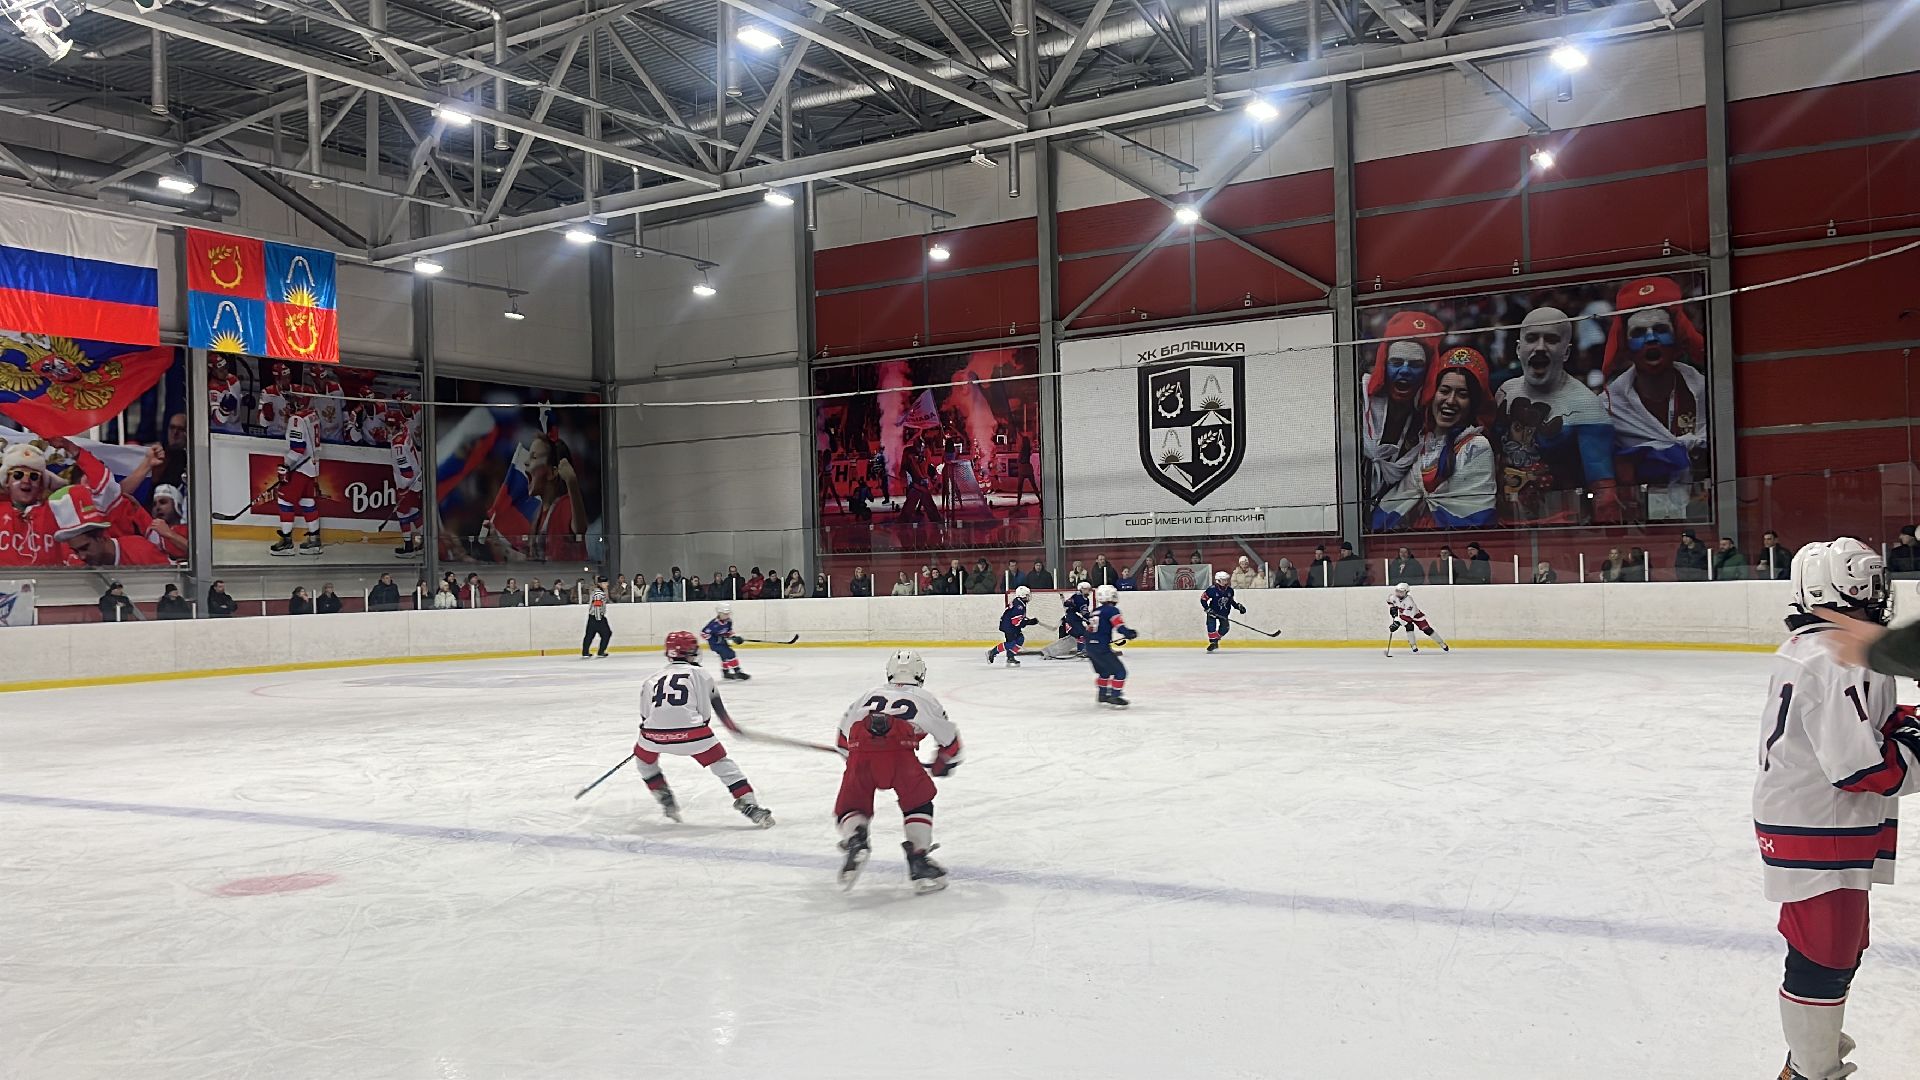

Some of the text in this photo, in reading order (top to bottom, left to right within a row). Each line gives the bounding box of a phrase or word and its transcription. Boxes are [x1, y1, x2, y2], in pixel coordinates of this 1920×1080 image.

[1137, 340, 1246, 363] ХК БАЛАШИХА
[345, 480, 397, 514] Boh
[1125, 518, 1153, 526] СШОР
[1155, 516, 1192, 525] ИМЕНИ
[0, 530, 54, 552] СССР
[651, 673, 691, 708] 45
